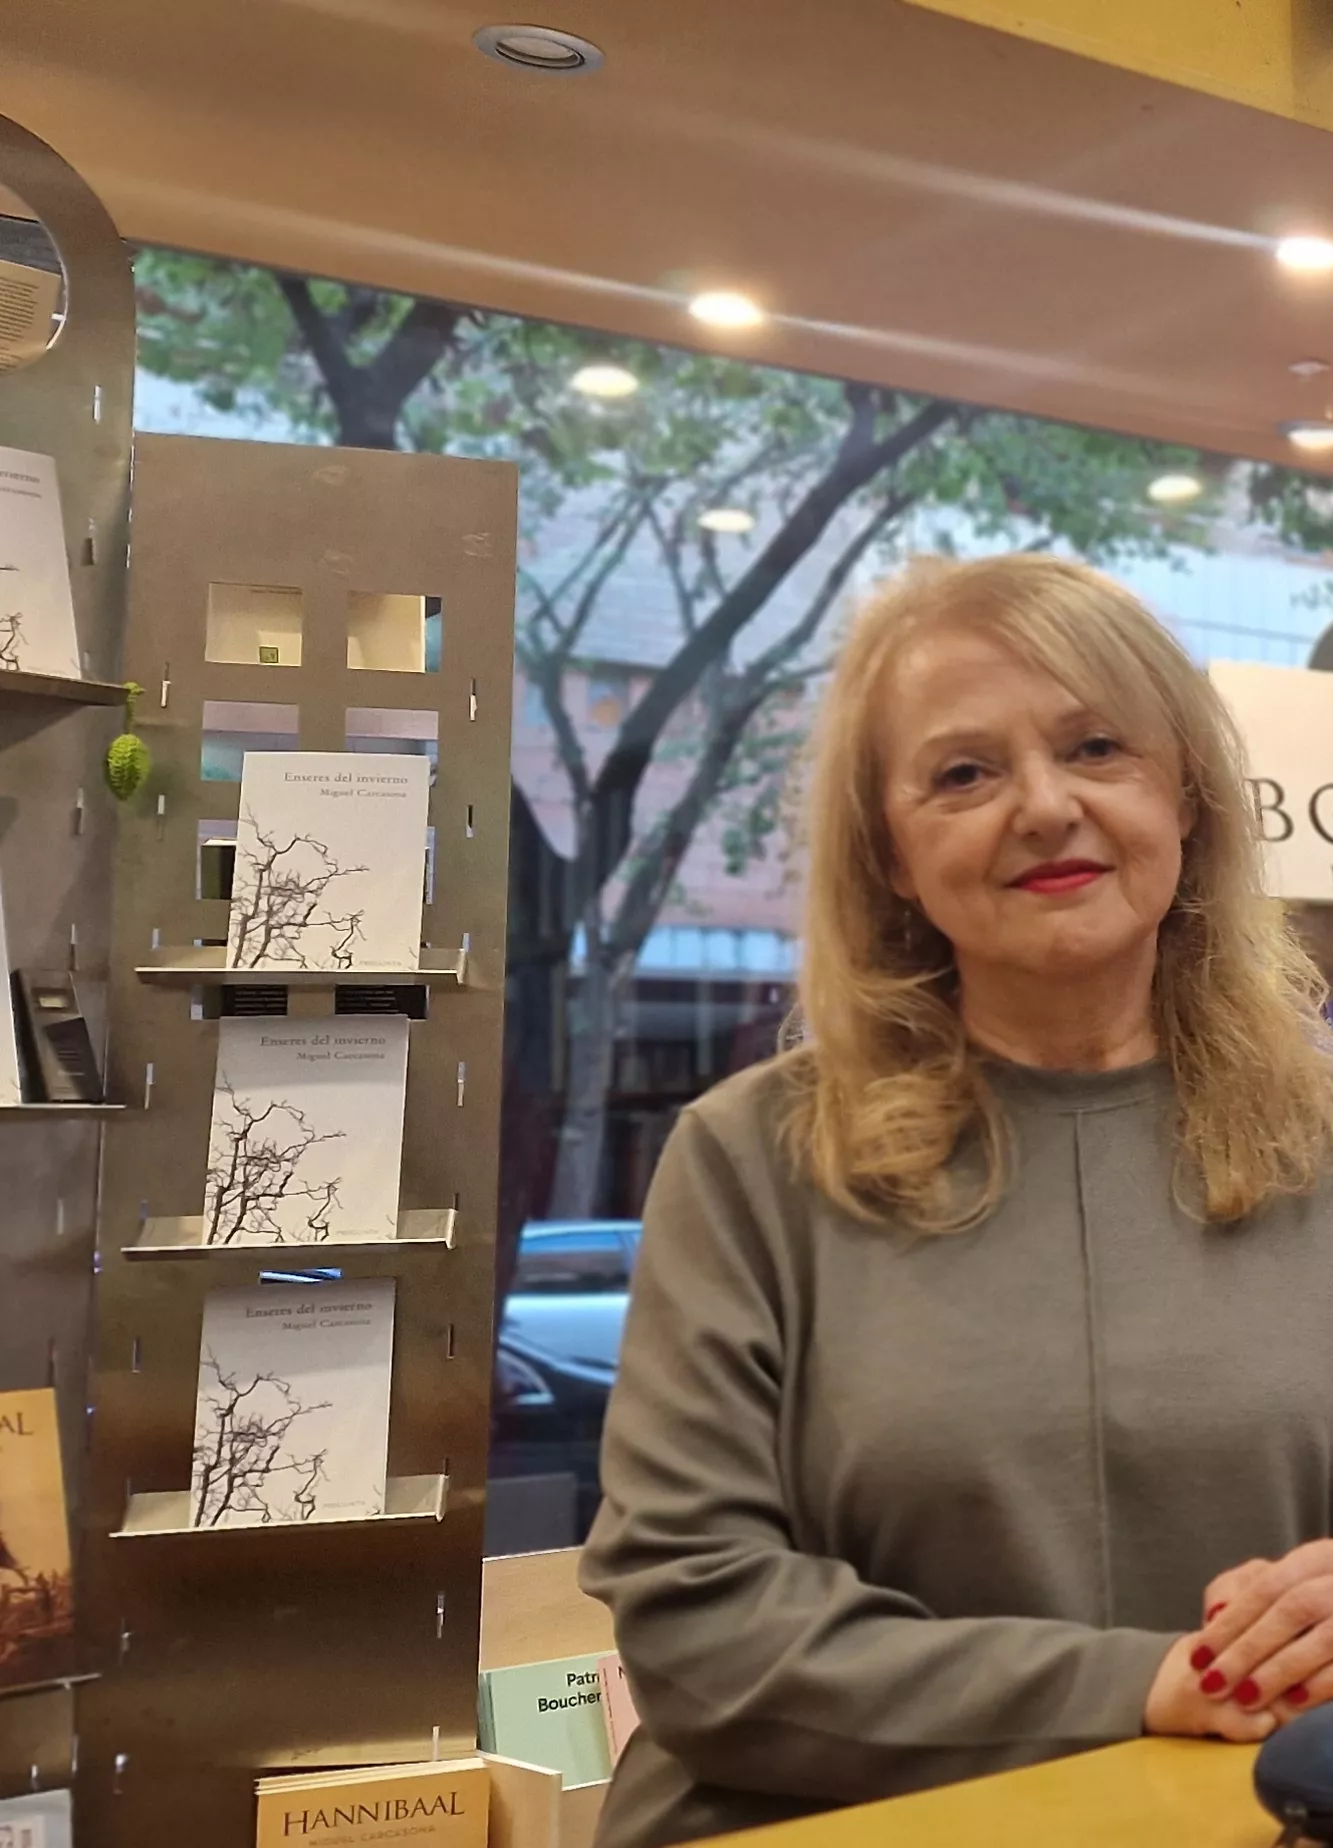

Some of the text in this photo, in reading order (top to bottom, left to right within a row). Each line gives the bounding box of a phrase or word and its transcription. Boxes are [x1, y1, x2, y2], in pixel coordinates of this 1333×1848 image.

[284, 771, 409, 785] Enseres del invierno
[319, 787, 408, 800] Miguel Carcasona
[260, 1034, 387, 1047] Enseres del invierno
[296, 1050, 332, 1062] Miguel
[246, 1302, 374, 1319] Enseres del invierno
[282, 1319, 317, 1332] Miguel
[284, 1792, 465, 1836] HANNIBAAL
